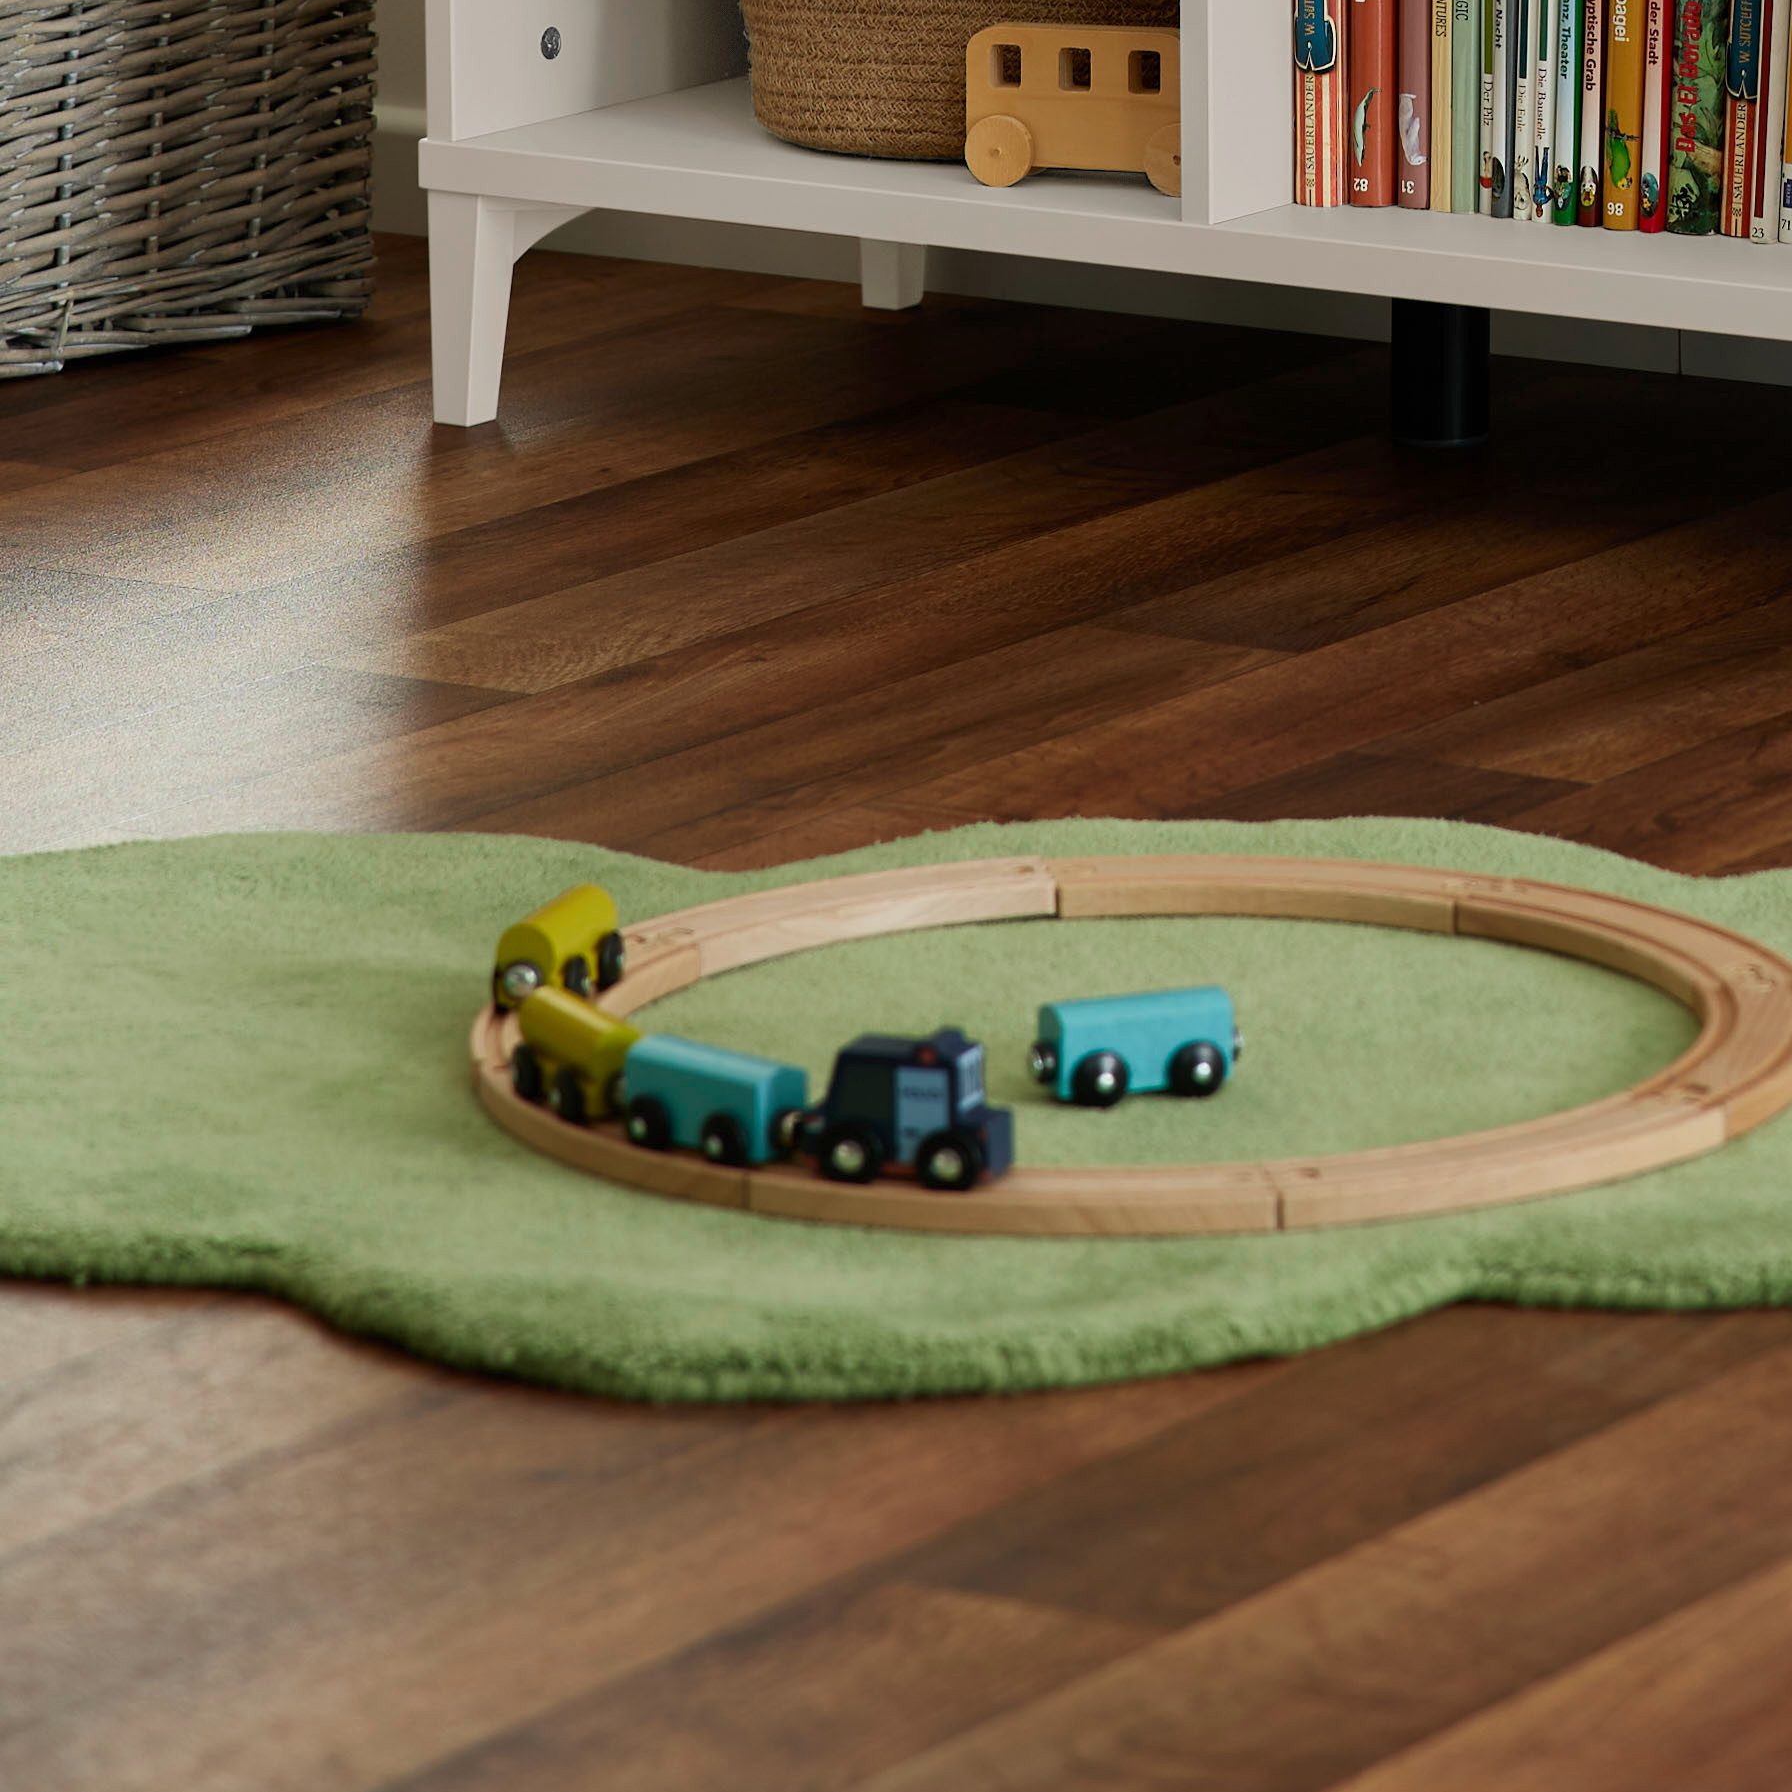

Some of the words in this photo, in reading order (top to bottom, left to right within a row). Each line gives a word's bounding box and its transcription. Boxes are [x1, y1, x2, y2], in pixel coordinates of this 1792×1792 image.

[1649, 1, 1661, 26] der
[1494, 9, 1504, 49] Nacht
[1678, 0, 1702, 78] Dorado
[1560, 26, 1572, 80] Theater
[1648, 28, 1660, 66] Stadt
[1739, 51, 1750, 63] W.
[1538, 68, 1548, 88] Die
[1584, 58, 1597, 92] Grab
[1483, 81, 1494, 103] Der
[1517, 84, 1527, 100] Die
[1677, 84, 1698, 105] El
[1483, 106, 1494, 127] Pilz
[1536, 92, 1547, 140] Baustelle
[1675, 113, 1697, 153] Das
[1353, 178, 1368, 191] 82
[1401, 180, 1414, 194] 31
[1607, 201, 1624, 216] 86
[1752, 227, 1764, 239] 23
[1781, 219, 1791, 231] 71
